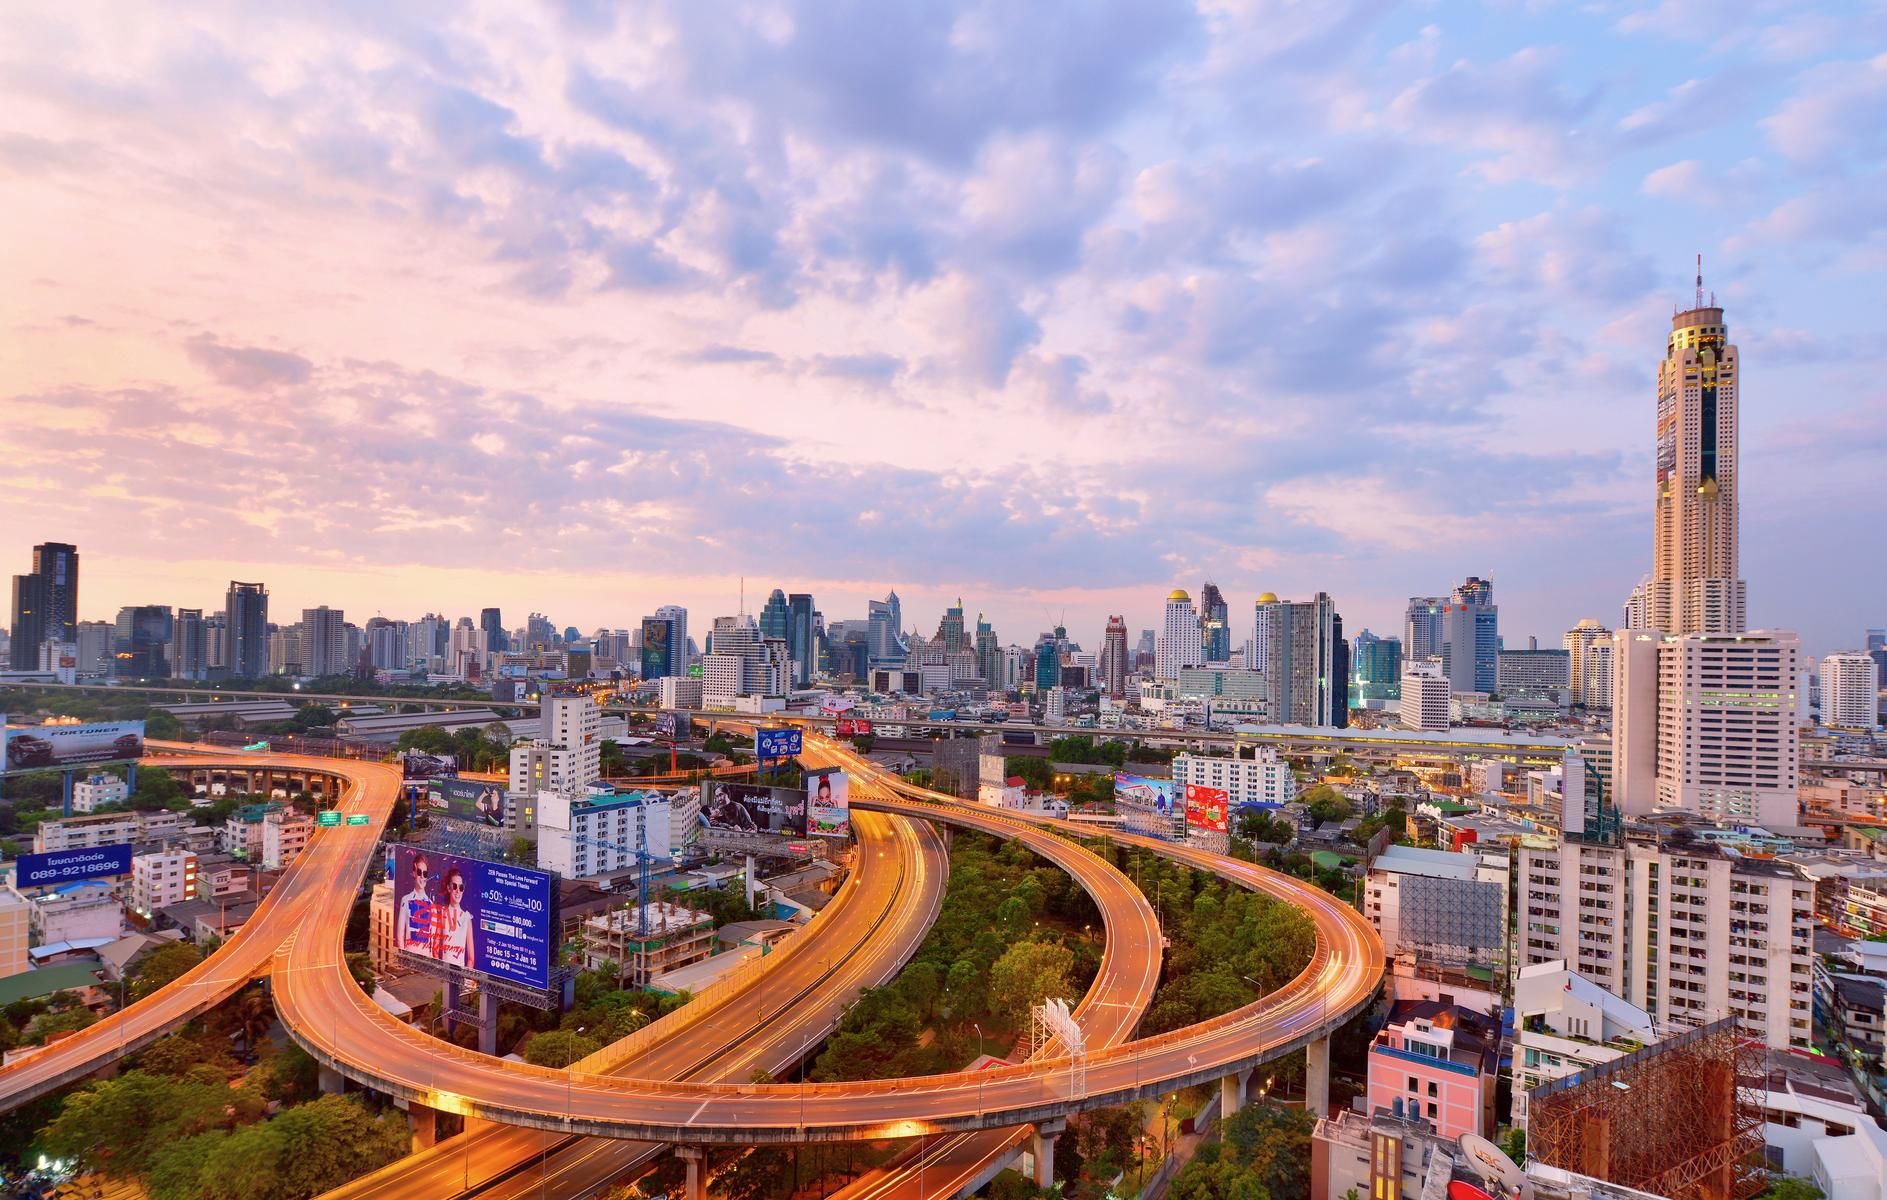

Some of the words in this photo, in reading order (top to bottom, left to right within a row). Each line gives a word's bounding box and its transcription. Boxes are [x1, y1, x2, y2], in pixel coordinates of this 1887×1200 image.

[51, 727, 120, 737] FORTUNER
[30, 860, 120, 880] 089-9218696
[493, 947, 503, 956] Dec
[503, 949, 511, 958] 15
[519, 953, 529, 963] Jan
[529, 956, 537, 966] 16
